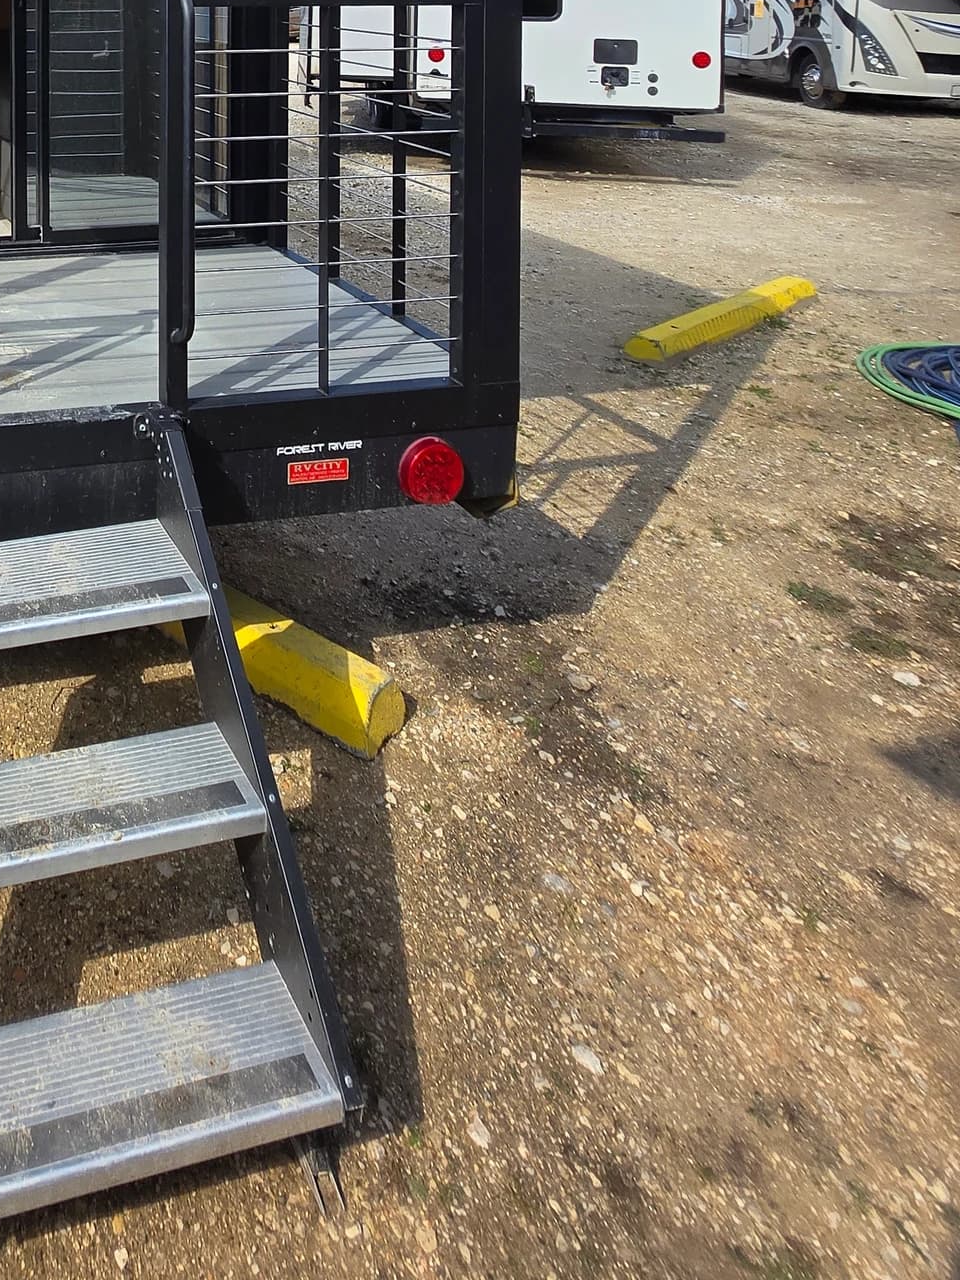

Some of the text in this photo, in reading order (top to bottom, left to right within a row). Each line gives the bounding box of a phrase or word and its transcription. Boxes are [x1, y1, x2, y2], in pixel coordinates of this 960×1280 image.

[276, 440, 363, 456] FOREST RIVER
[294, 461, 343, 472] RV CITY
